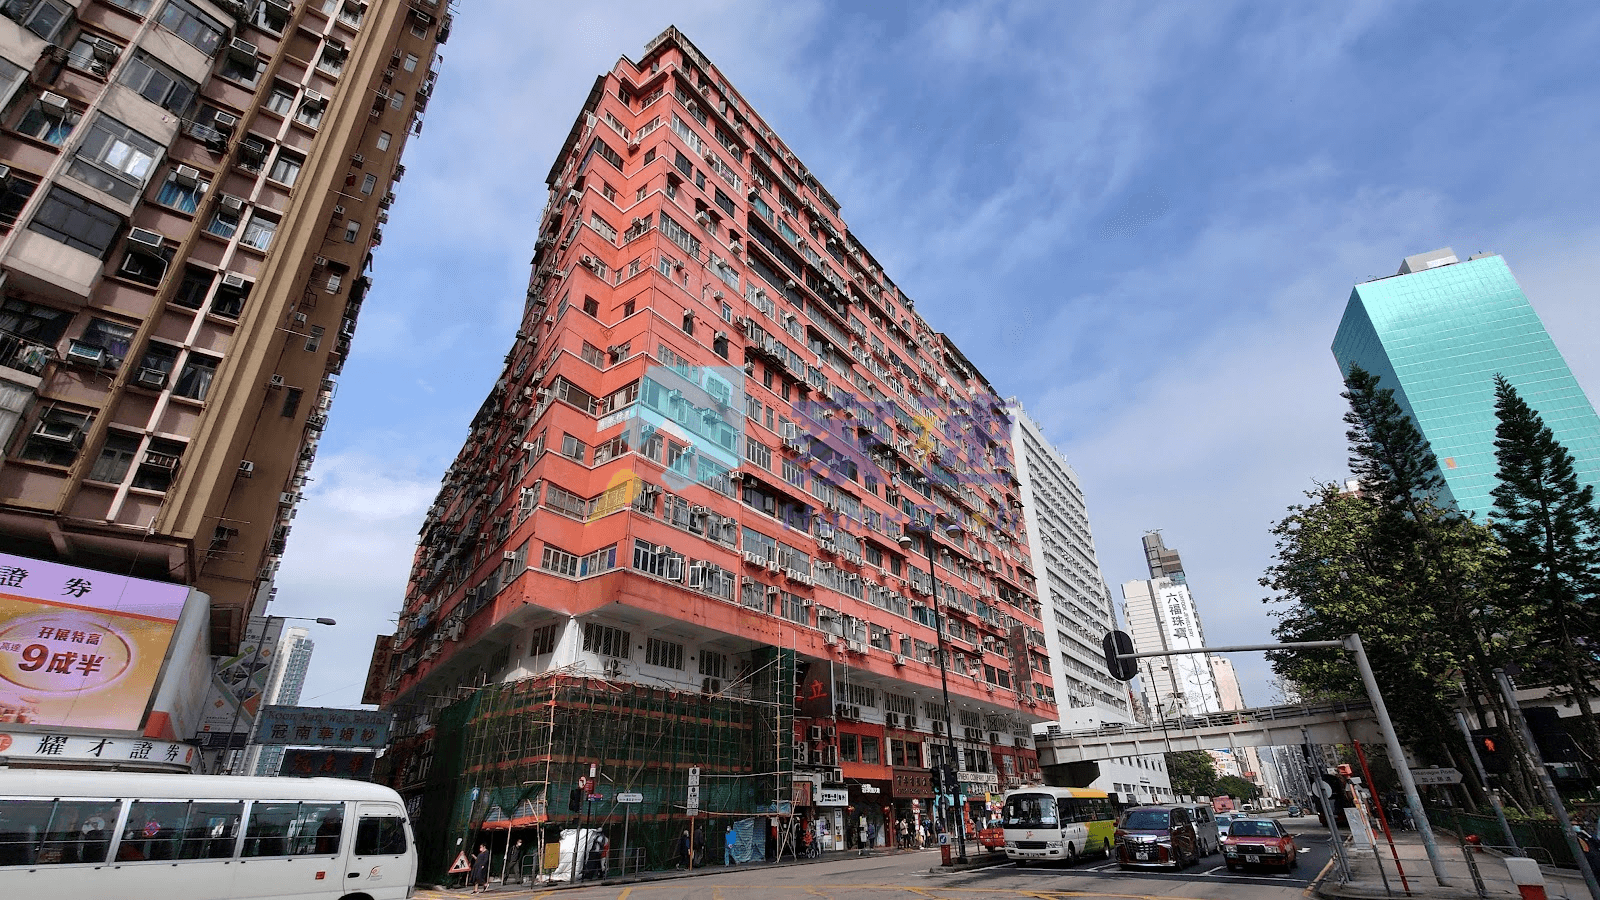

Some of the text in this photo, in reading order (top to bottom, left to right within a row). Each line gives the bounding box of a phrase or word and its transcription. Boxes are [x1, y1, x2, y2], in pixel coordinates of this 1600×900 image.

[0, 566, 92, 598] 證券
[1166, 592, 1188, 639] 六福珠寶
[38, 626, 102, 645] 孖展特高
[18, 644, 104, 676] 9成半
[271, 724, 377, 741] 冠南華婚紗
[35, 735, 181, 762] 耀才證券
